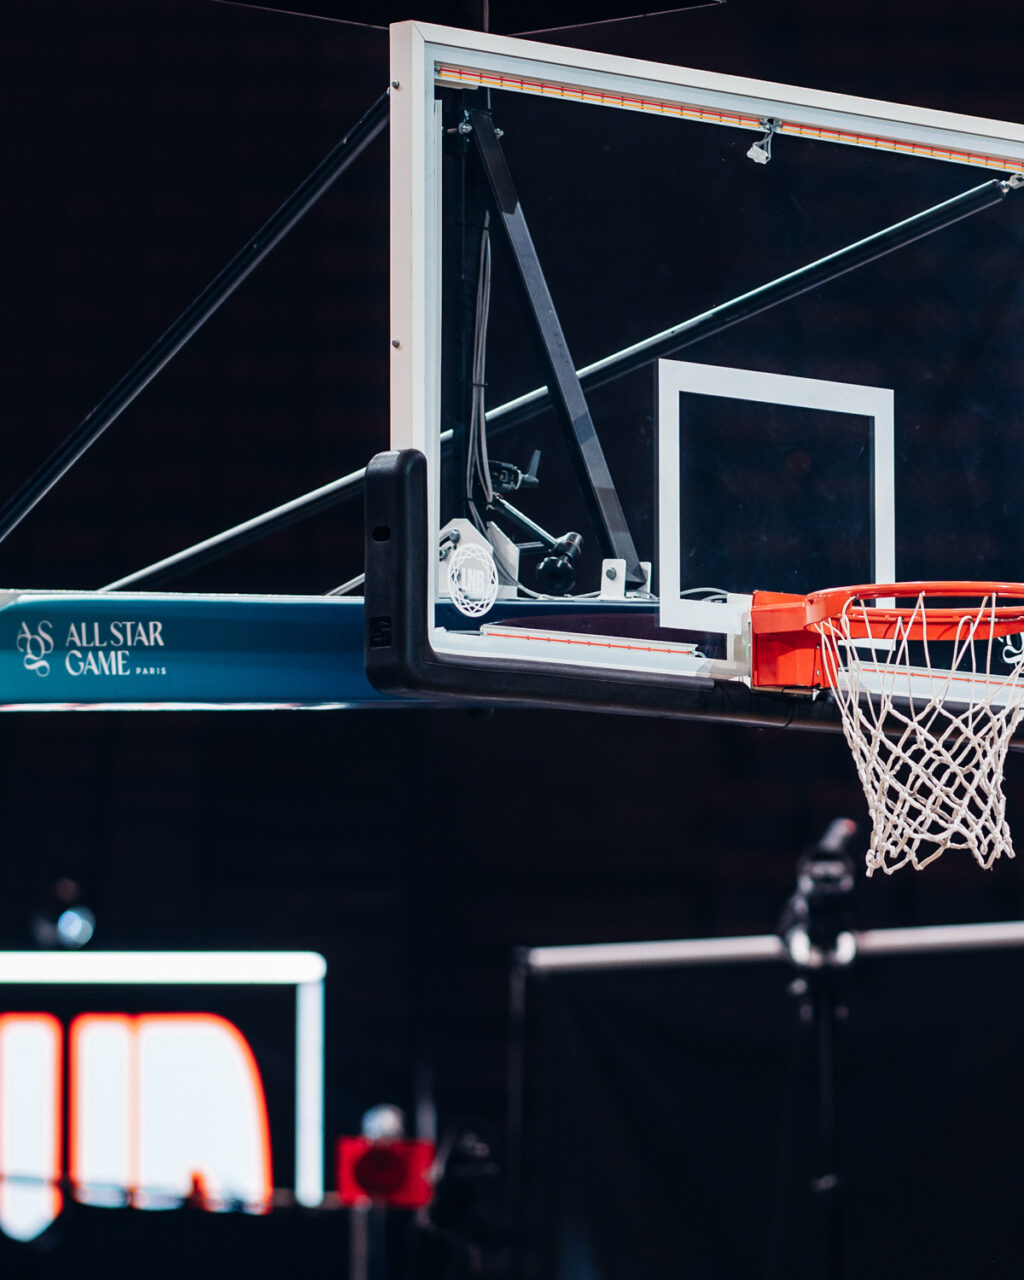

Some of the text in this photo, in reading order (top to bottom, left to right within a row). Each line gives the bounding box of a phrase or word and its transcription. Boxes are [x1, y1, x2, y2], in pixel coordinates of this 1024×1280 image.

[65, 621, 165, 647] ALL STAR
[65, 650, 167, 676] GAME PARIS
